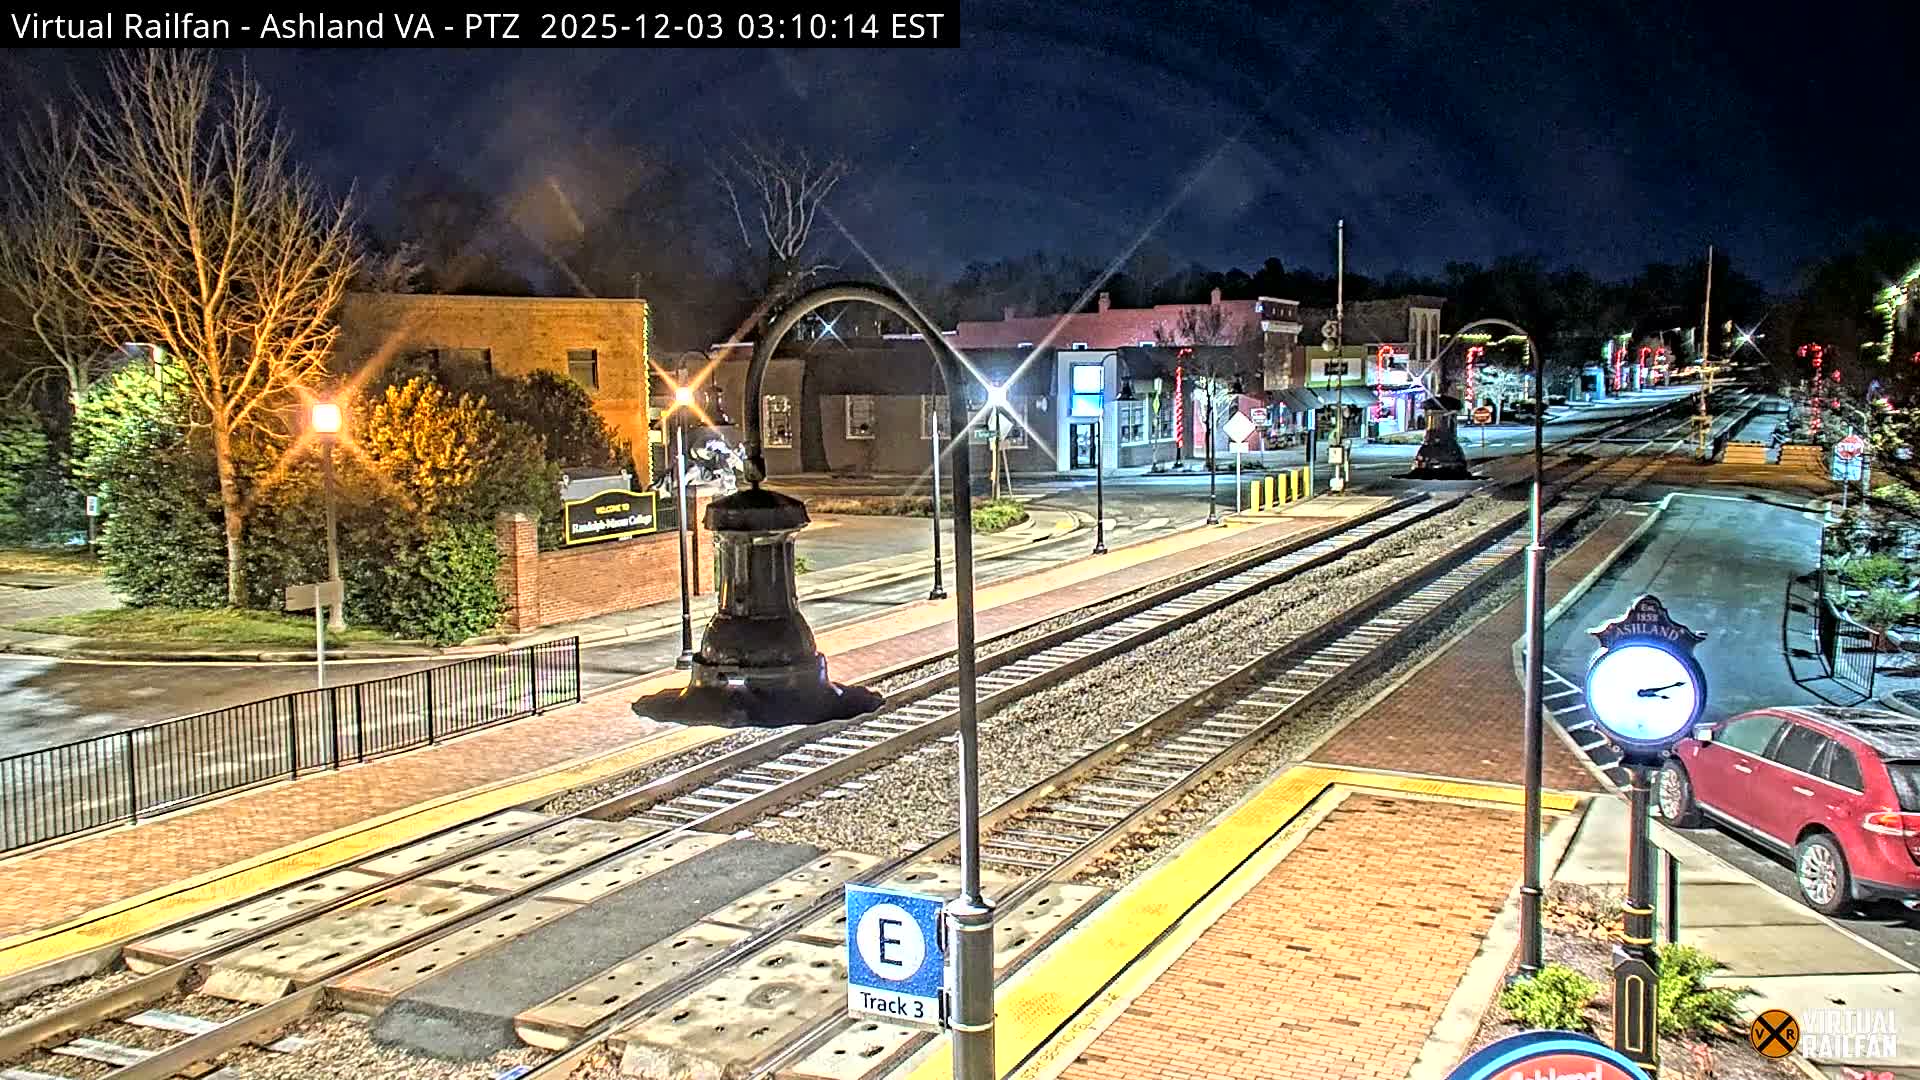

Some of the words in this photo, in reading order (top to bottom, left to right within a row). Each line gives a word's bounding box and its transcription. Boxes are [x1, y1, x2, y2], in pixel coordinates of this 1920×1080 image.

[1616, 623, 1679, 640] ASHLAND
[879, 918, 903, 967] E
[860, 991, 908, 1016] Track
[914, 1000, 924, 1018] 3
[1510, 1063, 1603, 1080] Ahland
